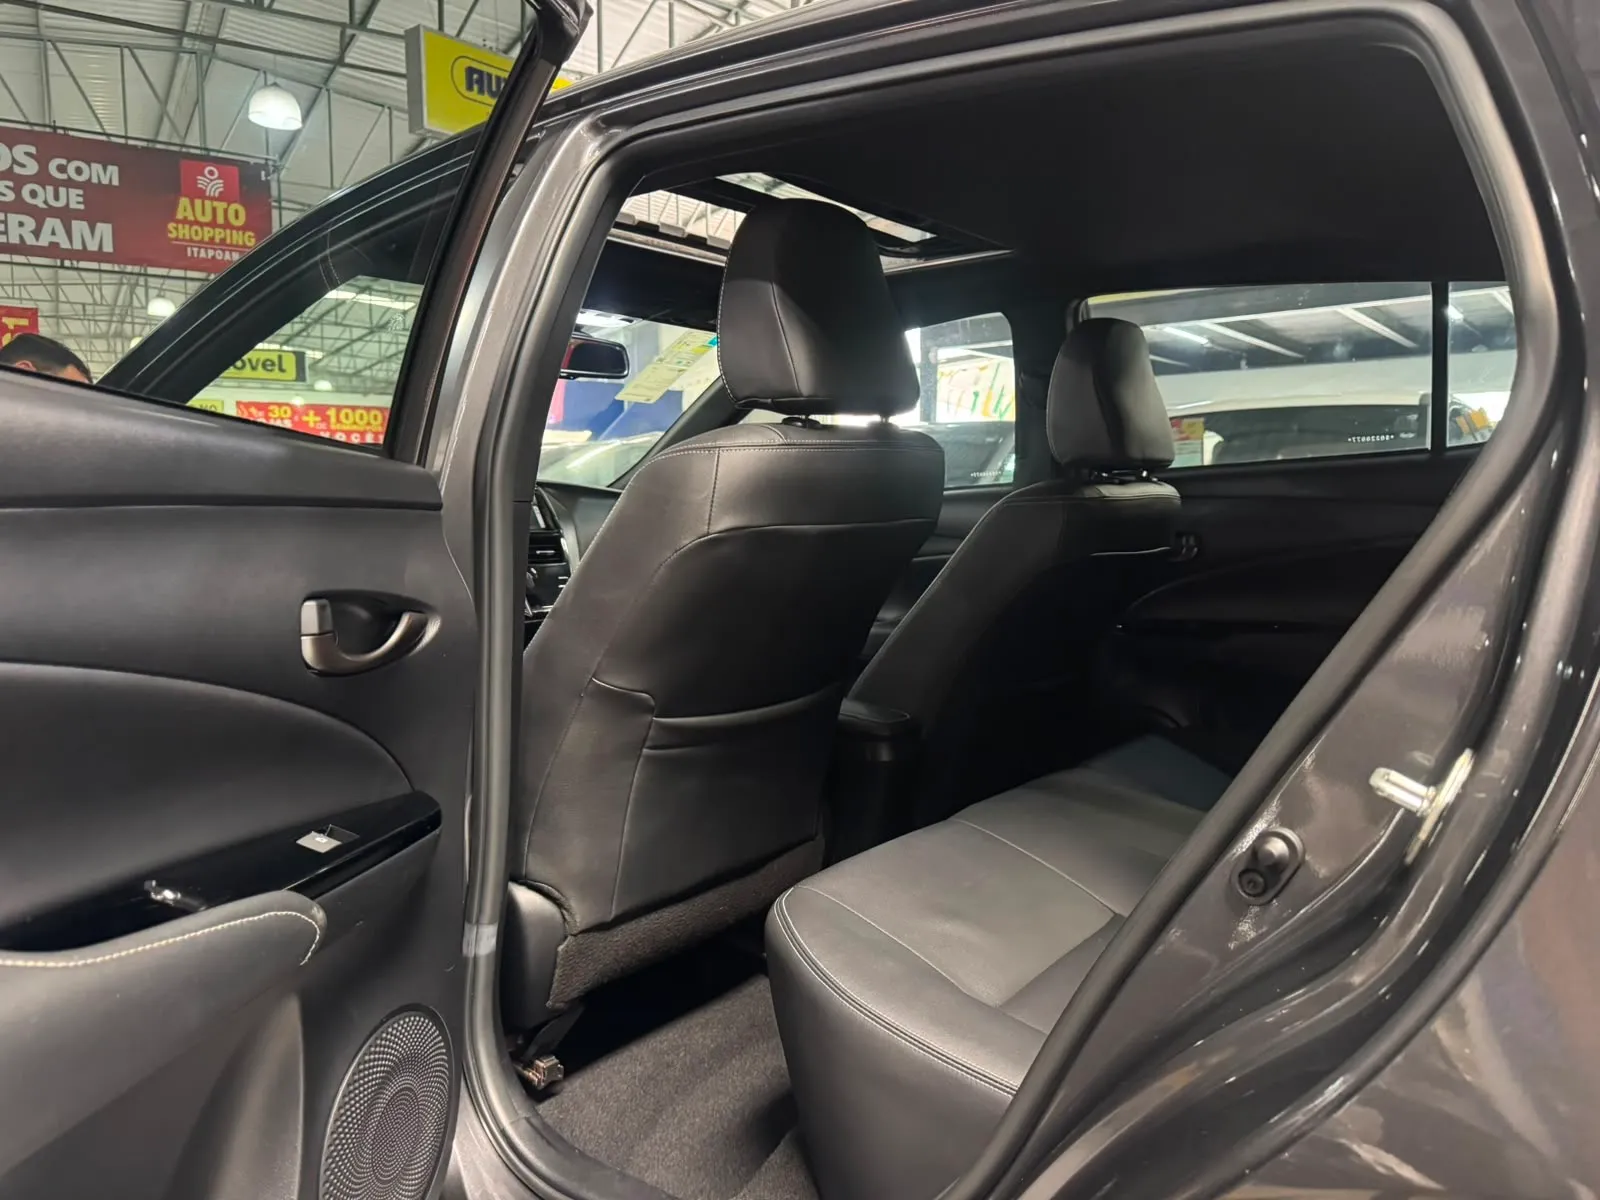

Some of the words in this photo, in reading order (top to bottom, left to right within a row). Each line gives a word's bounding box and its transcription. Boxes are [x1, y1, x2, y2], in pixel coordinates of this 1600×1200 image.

[465, 66, 506, 99] AU
[48, 158, 120, 186] COM
[21, 183, 85, 210] QUE
[175, 197, 246, 227] AUTO
[167, 222, 256, 247] SHOPPING
